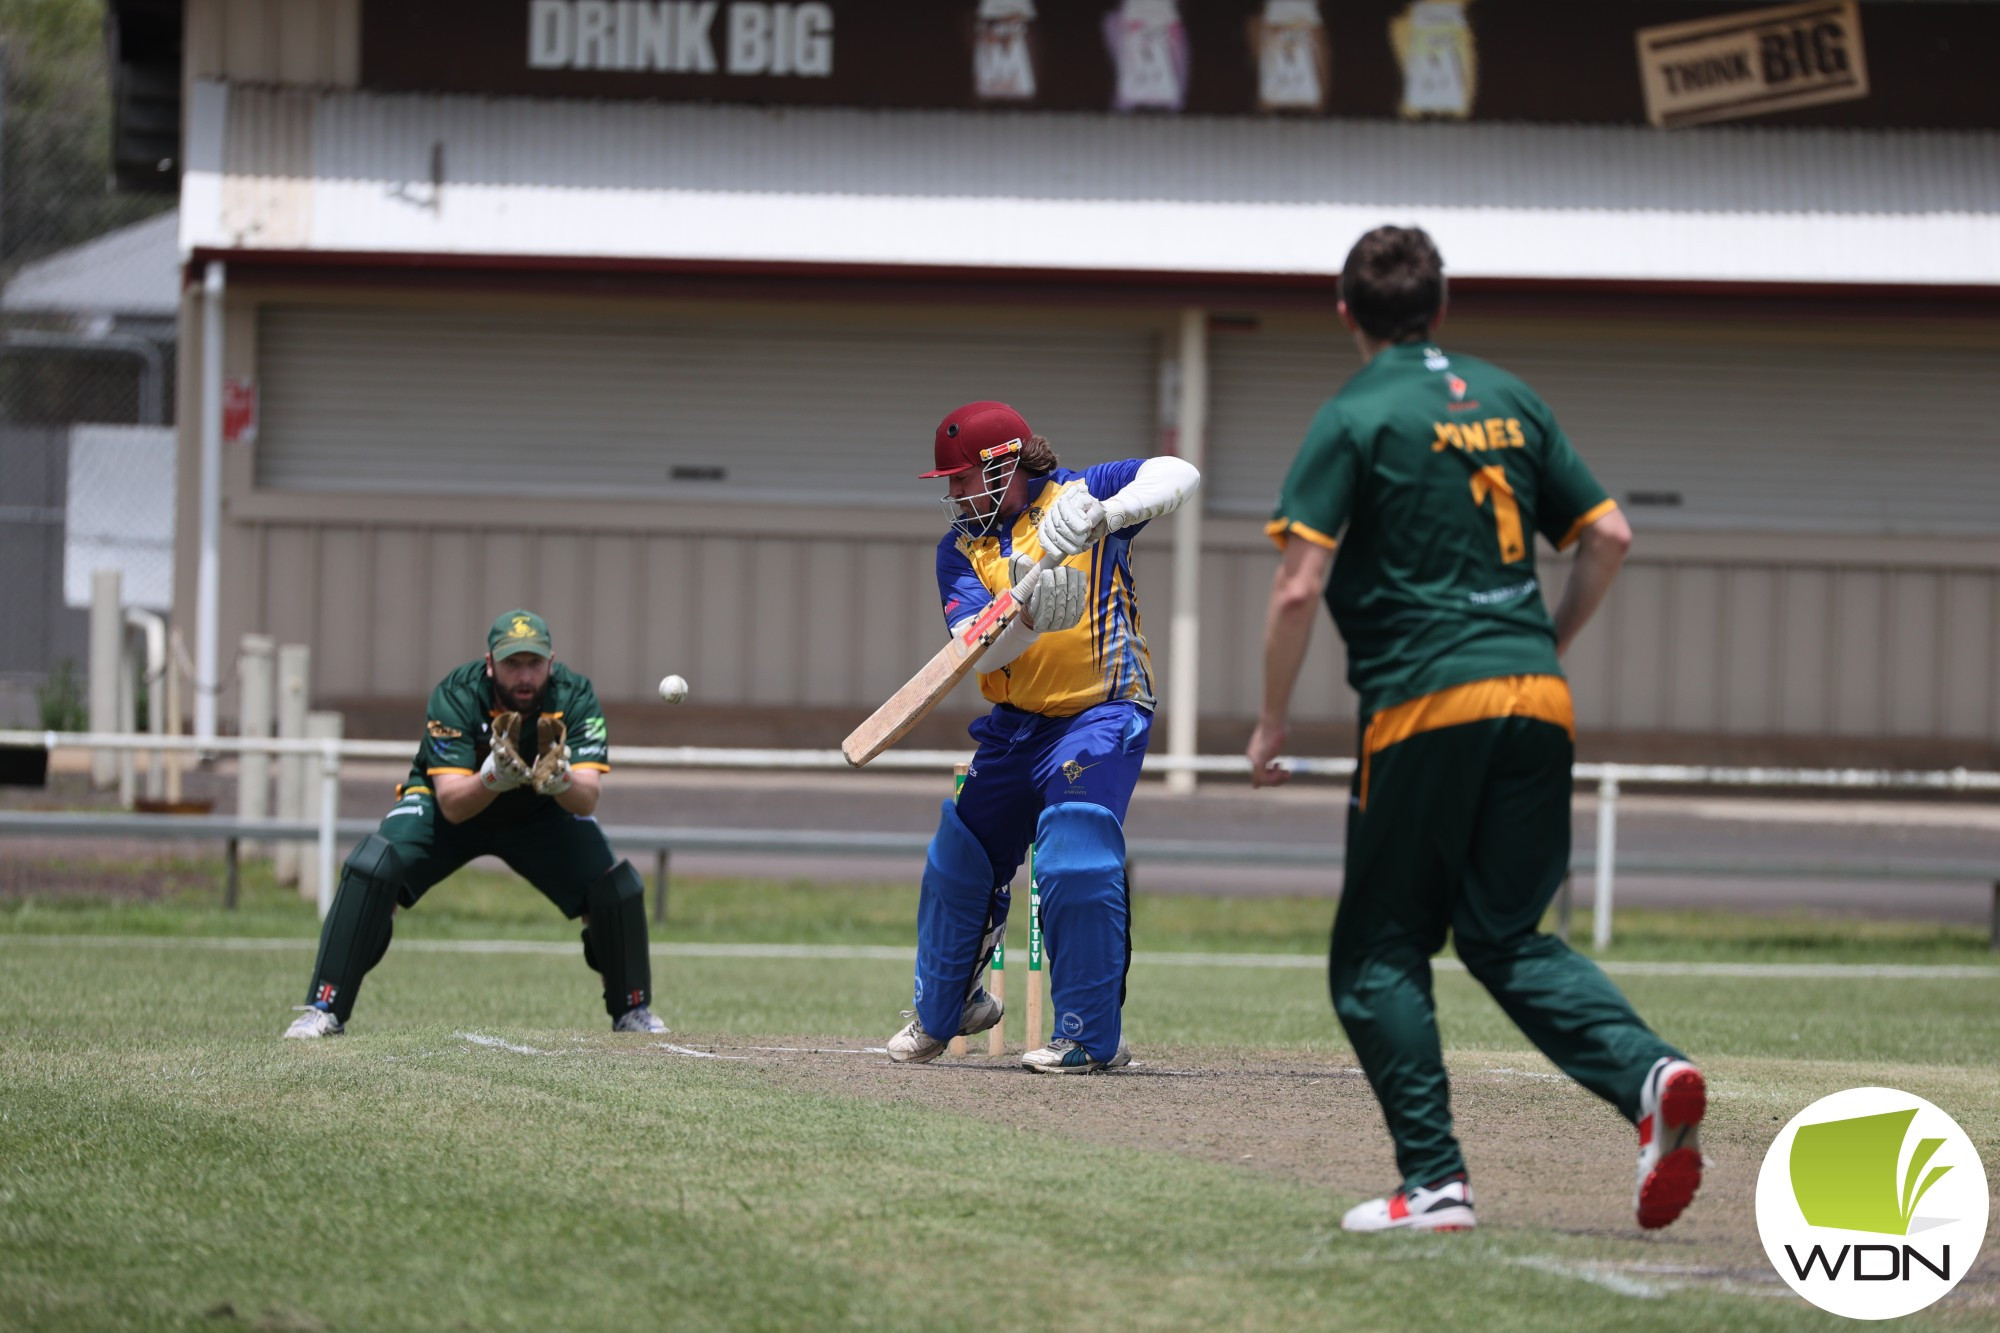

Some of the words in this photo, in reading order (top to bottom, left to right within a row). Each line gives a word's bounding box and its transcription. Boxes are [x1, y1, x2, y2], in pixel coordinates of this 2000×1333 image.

[528, 0, 717, 73] DRINK
[728, 2, 834, 77] BIG
[1661, 52, 1753, 96] THINK
[1762, 22, 1848, 83] BIG
[1432, 418, 1525, 453] JONES
